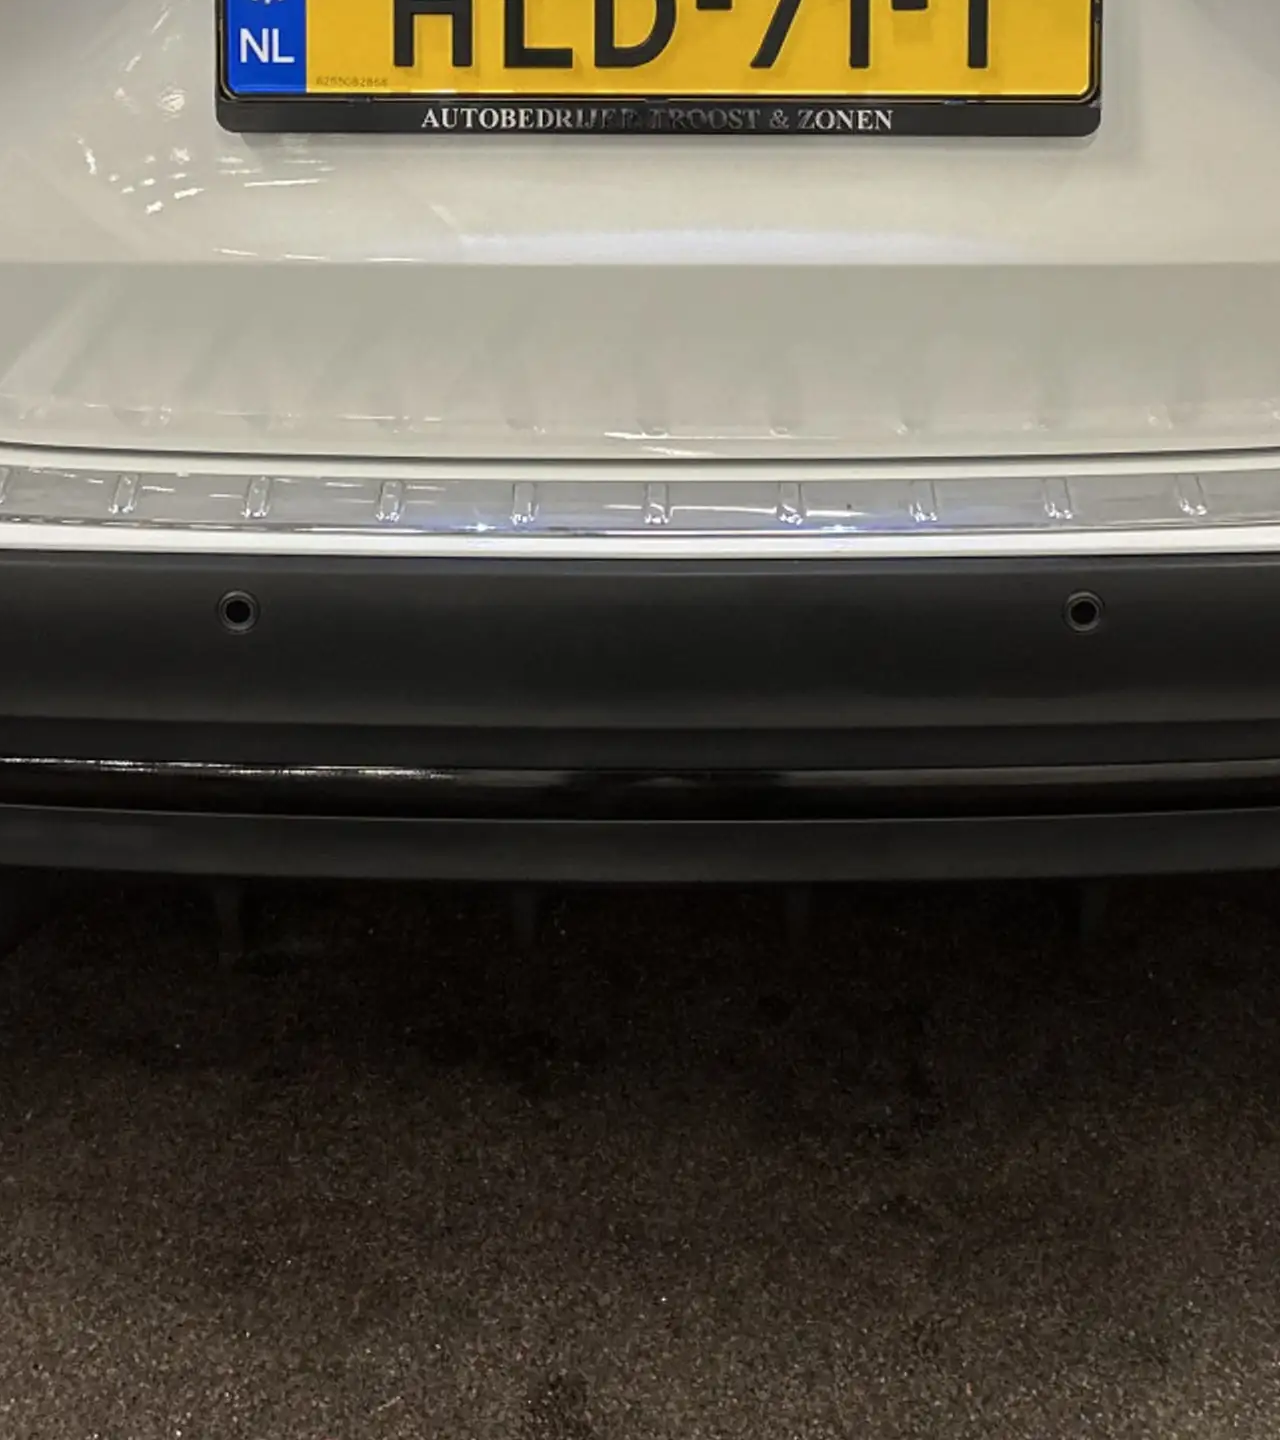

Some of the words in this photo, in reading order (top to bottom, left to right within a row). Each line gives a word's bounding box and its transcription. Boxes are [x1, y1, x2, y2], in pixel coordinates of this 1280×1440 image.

[239, 27, 295, 63] NL
[769, 109, 790, 129] &
[797, 109, 893, 130] ZONEN
